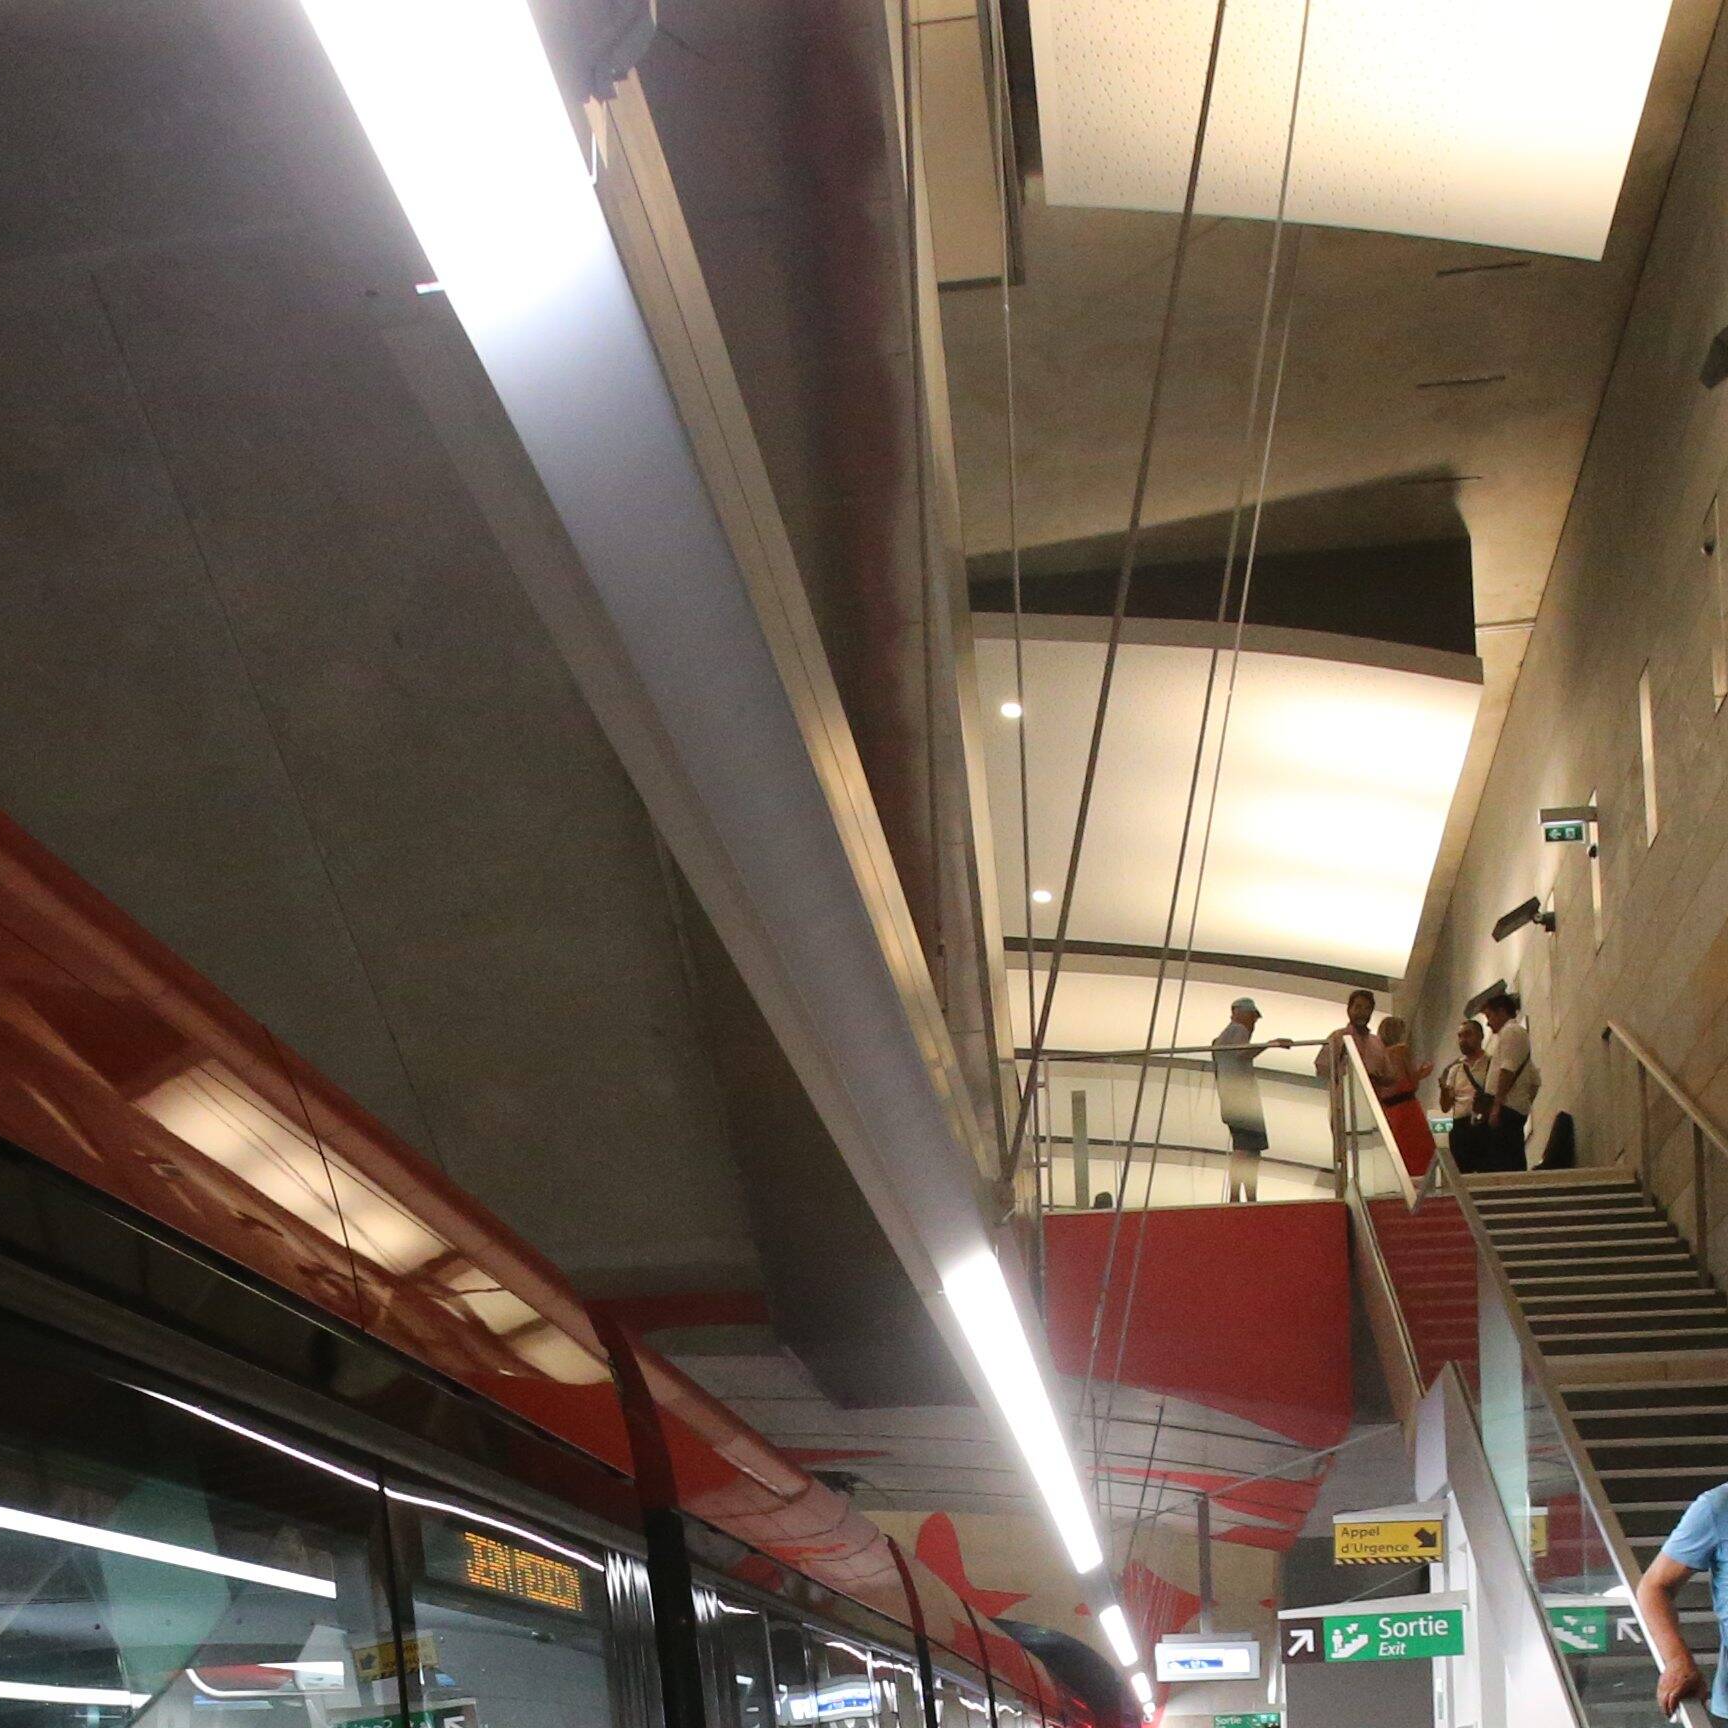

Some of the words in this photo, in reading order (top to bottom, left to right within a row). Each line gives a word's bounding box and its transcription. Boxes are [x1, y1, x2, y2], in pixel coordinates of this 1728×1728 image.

[1341, 1526, 1380, 1539] Appel
[1341, 1542, 1410, 1555] d'Urgence
[1378, 1615, 1449, 1638] Sortie
[1378, 1641, 1406, 1656] Exit
[1215, 1715, 1242, 1725] Sortie
